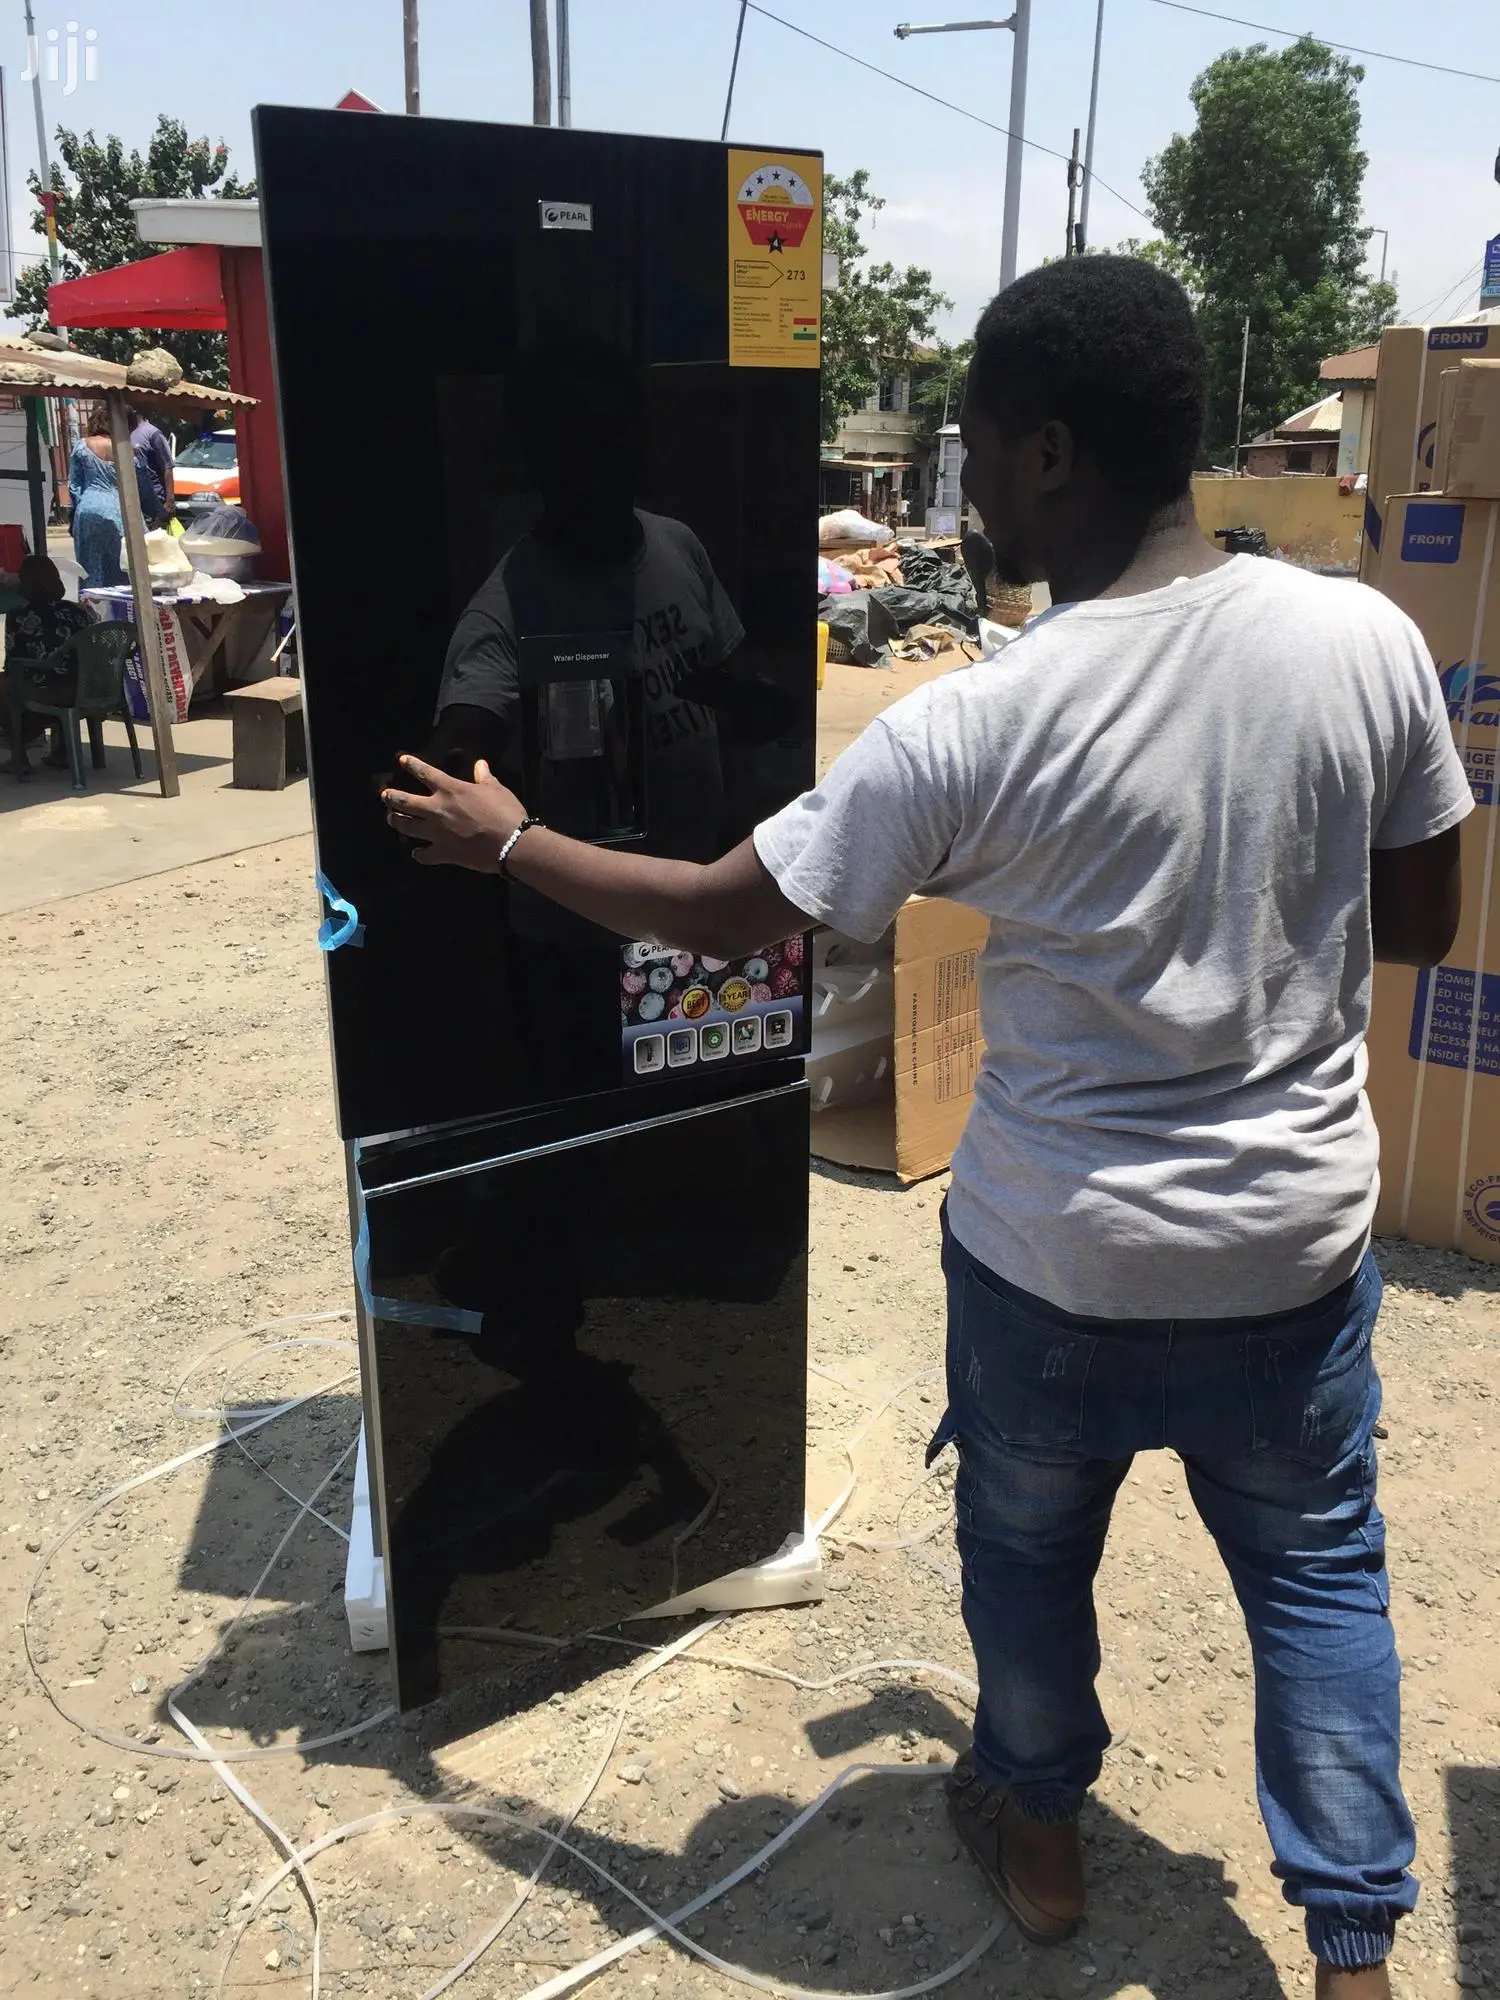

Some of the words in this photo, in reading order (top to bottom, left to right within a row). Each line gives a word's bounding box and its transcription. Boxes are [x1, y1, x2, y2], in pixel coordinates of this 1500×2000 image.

[560, 211, 589, 221] PEARL
[745, 206, 790, 224] ENERGY
[773, 239, 779, 247] 4
[786, 269, 806, 281] 273
[1430, 330, 1484, 345] FRONT
[1408, 533, 1454, 546] FRONT
[728, 990, 748, 1000] YEAR
[1432, 1003, 1462, 1016] OCK
[1430, 1017, 1465, 1032] GLASS
